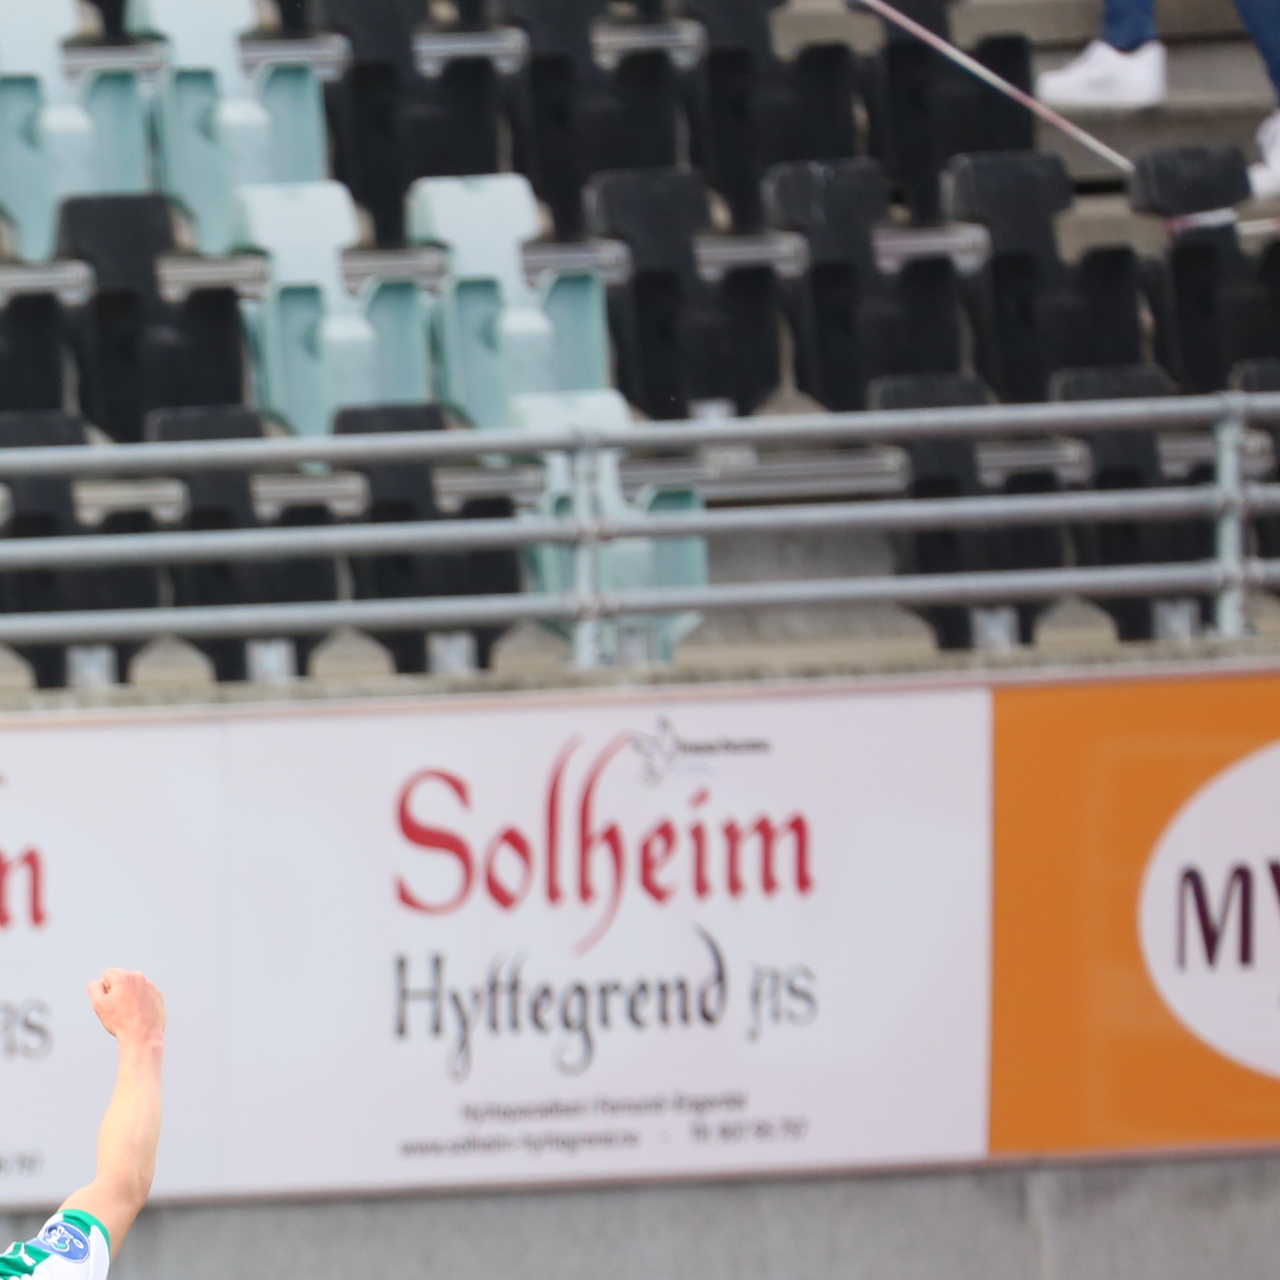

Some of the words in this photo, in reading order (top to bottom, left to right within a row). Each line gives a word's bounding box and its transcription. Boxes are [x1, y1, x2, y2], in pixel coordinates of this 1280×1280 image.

[393, 730, 816, 958] Solheim
[1175, 856, 1280, 970] M
[392, 922, 728, 1083] Hyttegrend
